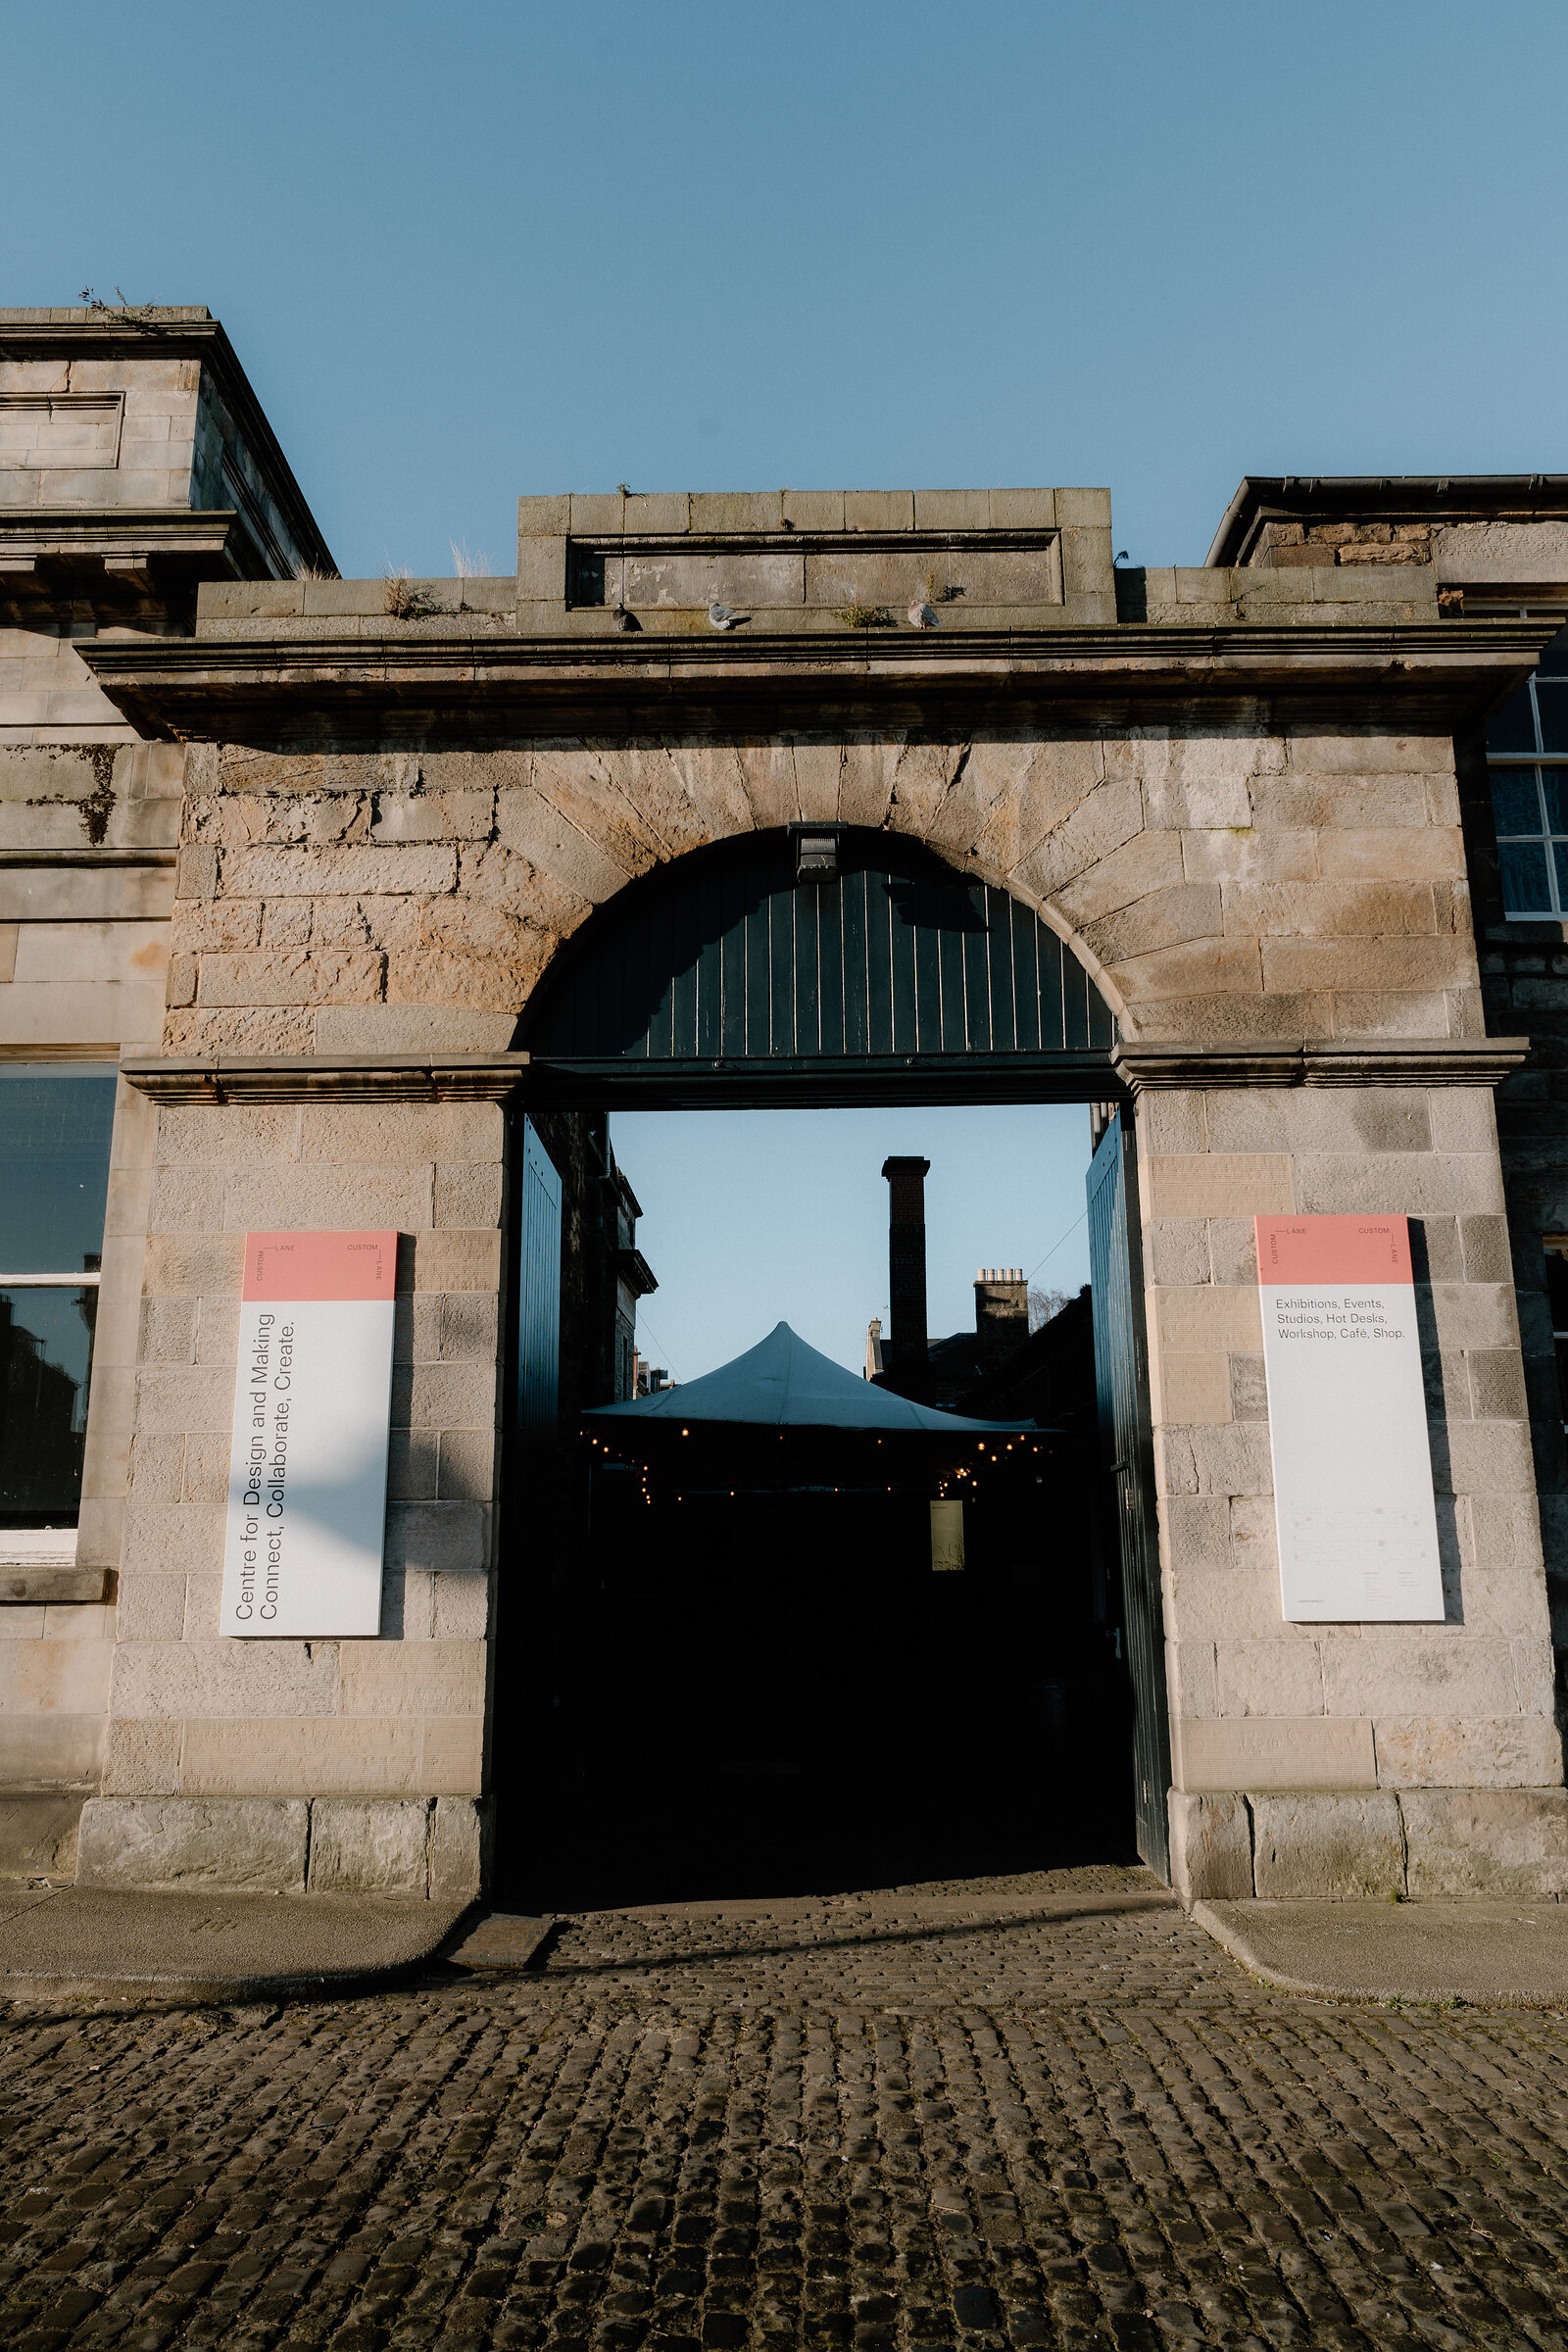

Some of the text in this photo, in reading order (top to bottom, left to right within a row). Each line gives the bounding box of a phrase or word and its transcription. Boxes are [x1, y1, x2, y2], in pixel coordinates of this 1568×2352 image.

[1270, 1233, 1279, 1265] CUSTOM
[256, 1250, 265, 1282] CUSTOM
[1276, 1298, 1385, 1310] Exhibitions, Events,
[1277, 1313, 1388, 1324] Studios, Hot Desks,
[1278, 1327, 1405, 1340] Workshop, Café, Shop.
[236, 1314, 275, 1620] Centre for Design and Making
[260, 1322, 294, 1620] Connect, Collaborate, Create.
